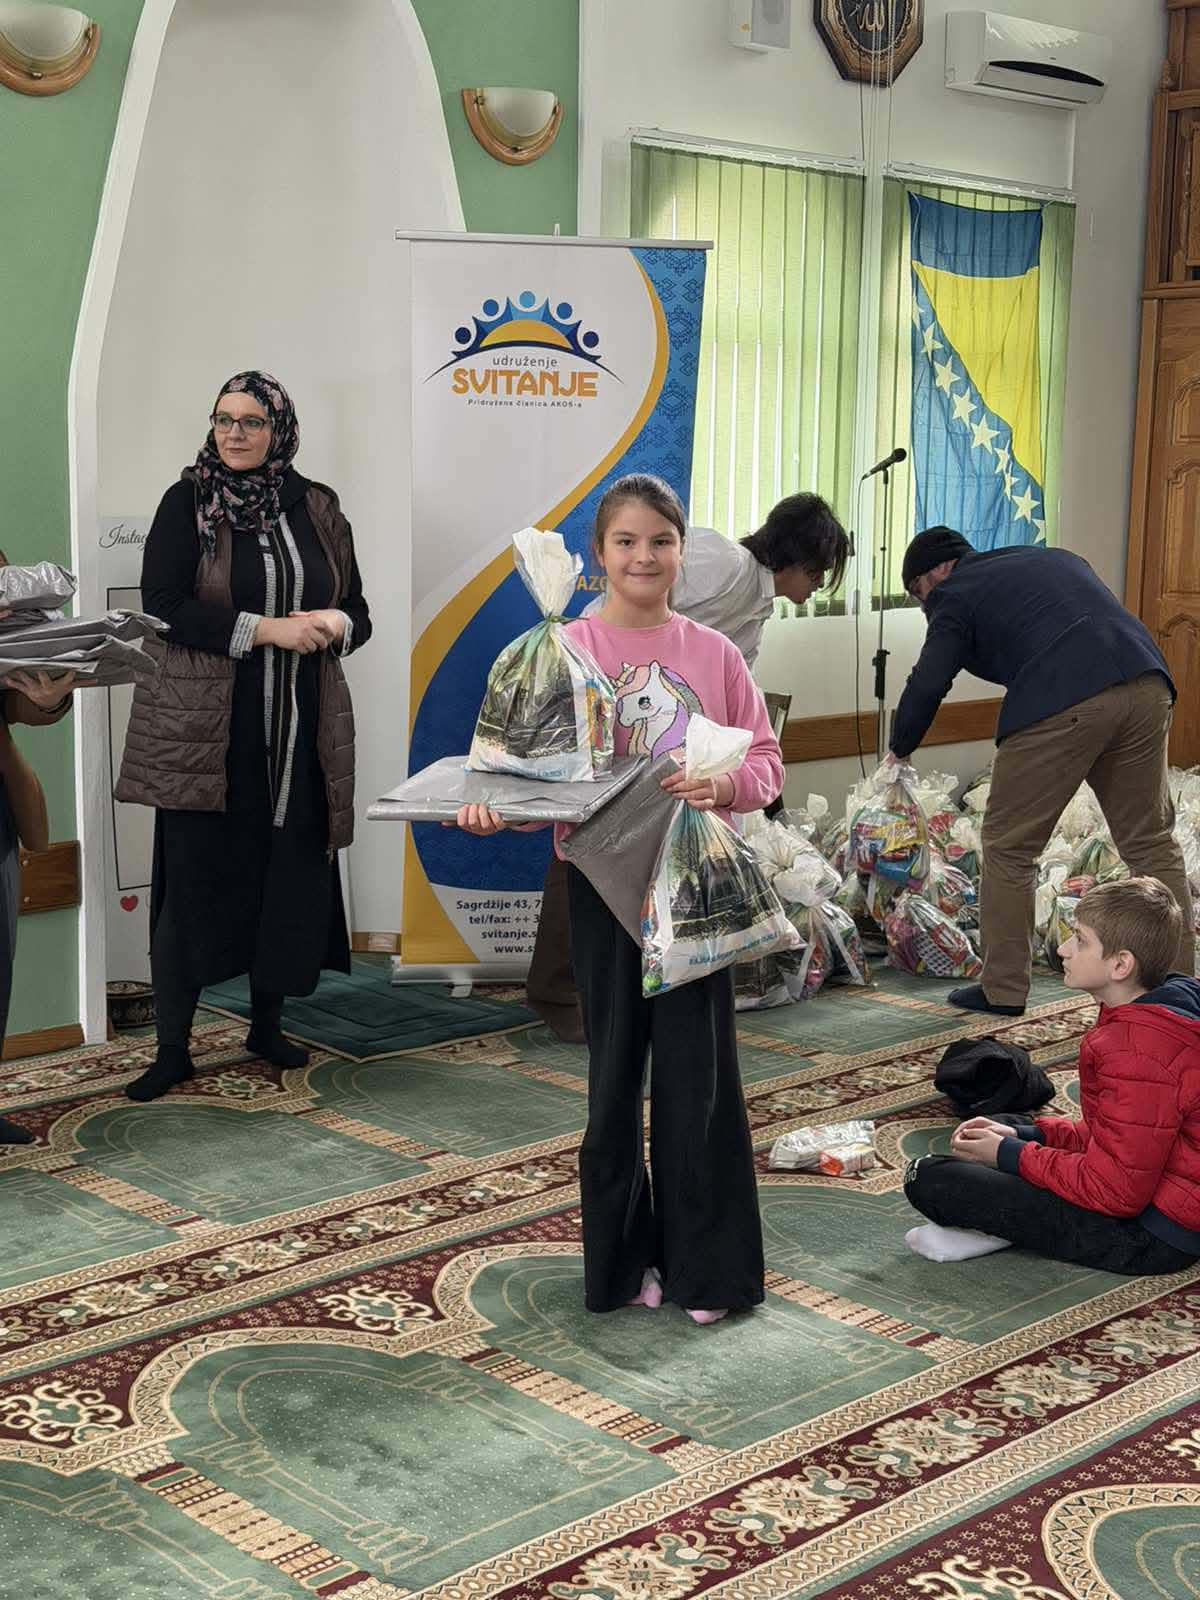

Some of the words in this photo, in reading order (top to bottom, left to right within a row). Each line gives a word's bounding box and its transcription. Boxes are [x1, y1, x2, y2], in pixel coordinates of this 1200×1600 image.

[492, 355, 558, 369] udruženje
[451, 367, 599, 397] SVITANJE
[456, 900, 511, 911] Sagrdžije
[513, 899, 532, 910] 43,
[469, 914, 511, 925] tel/fax:
[481, 930, 537, 940] svitanje.s
[494, 945, 535, 954] www.s
